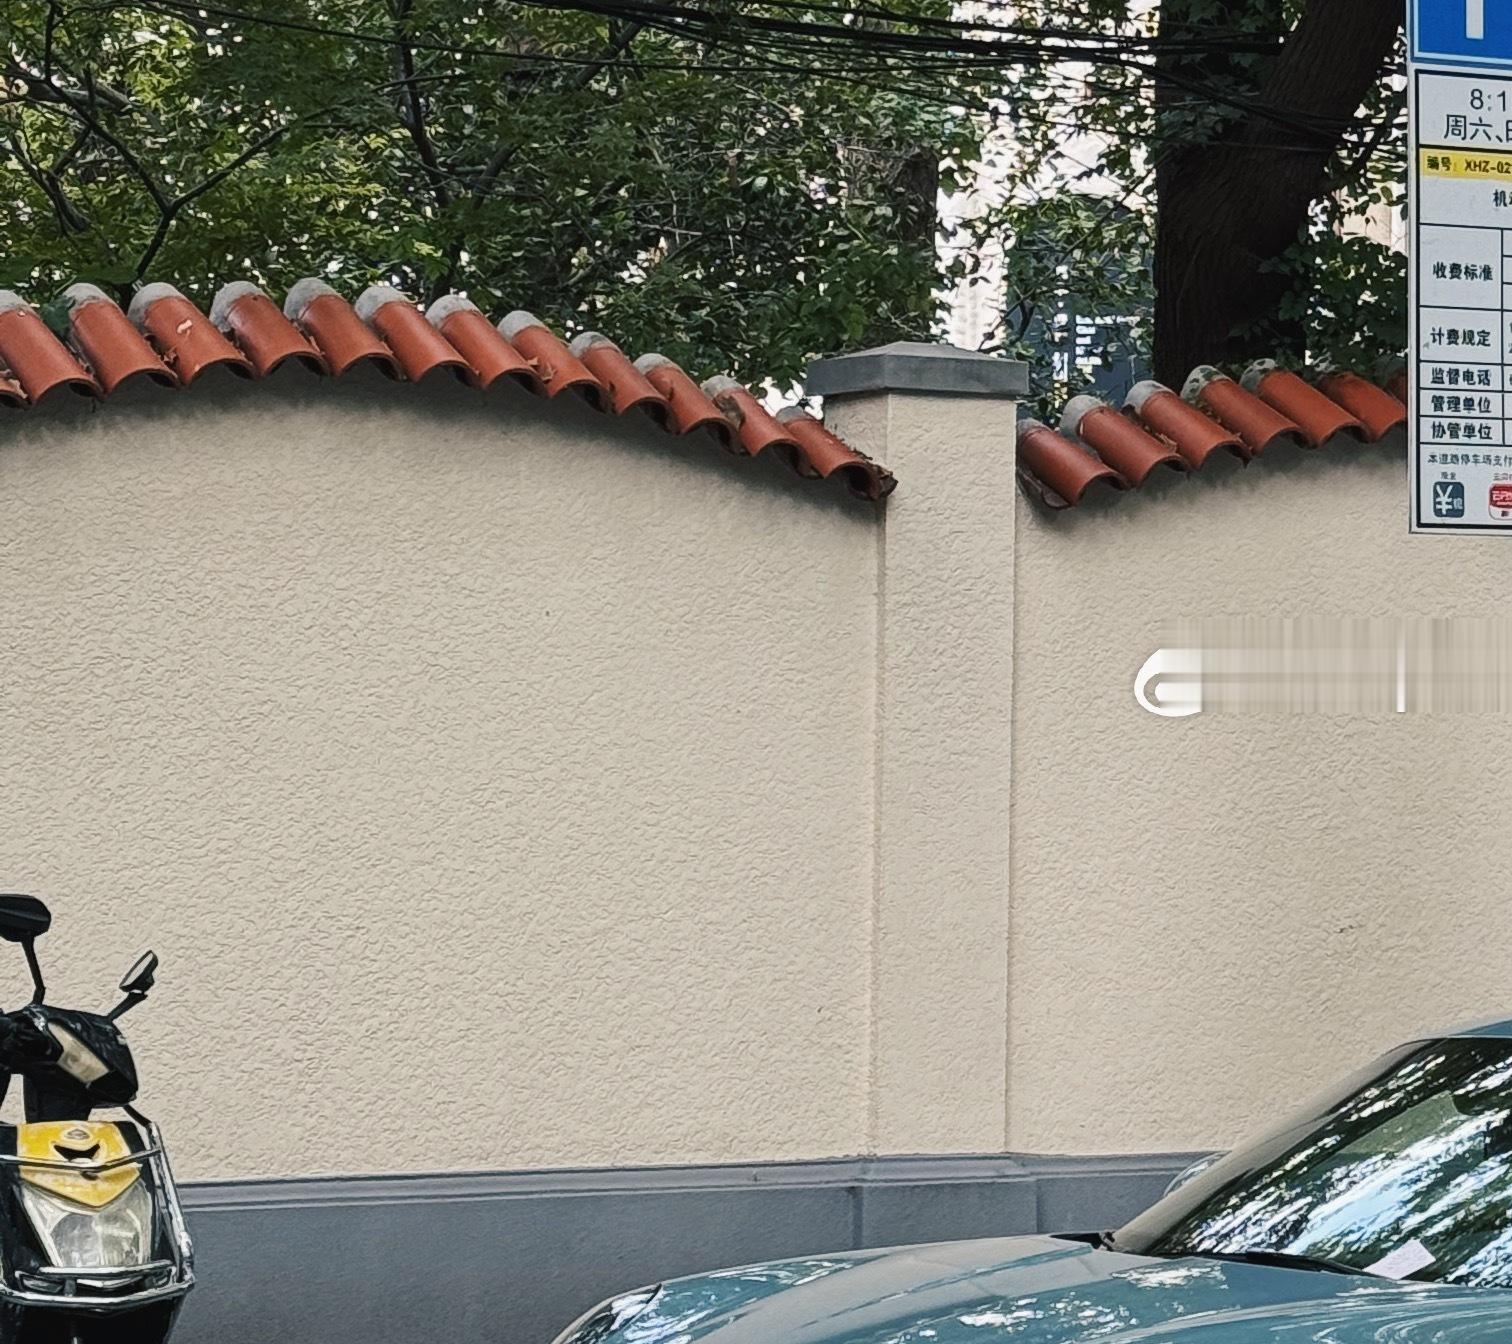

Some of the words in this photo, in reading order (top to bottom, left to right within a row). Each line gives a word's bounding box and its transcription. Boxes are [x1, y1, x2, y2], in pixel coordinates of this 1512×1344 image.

[1433, 262, 1493, 281] 收费标准
[1430, 327, 1491, 346] 计费规定
[1431, 367, 1491, 386] 监督电话
[1431, 395, 1492, 414] 管理单位
[1431, 421, 1492, 440] 协管单位
